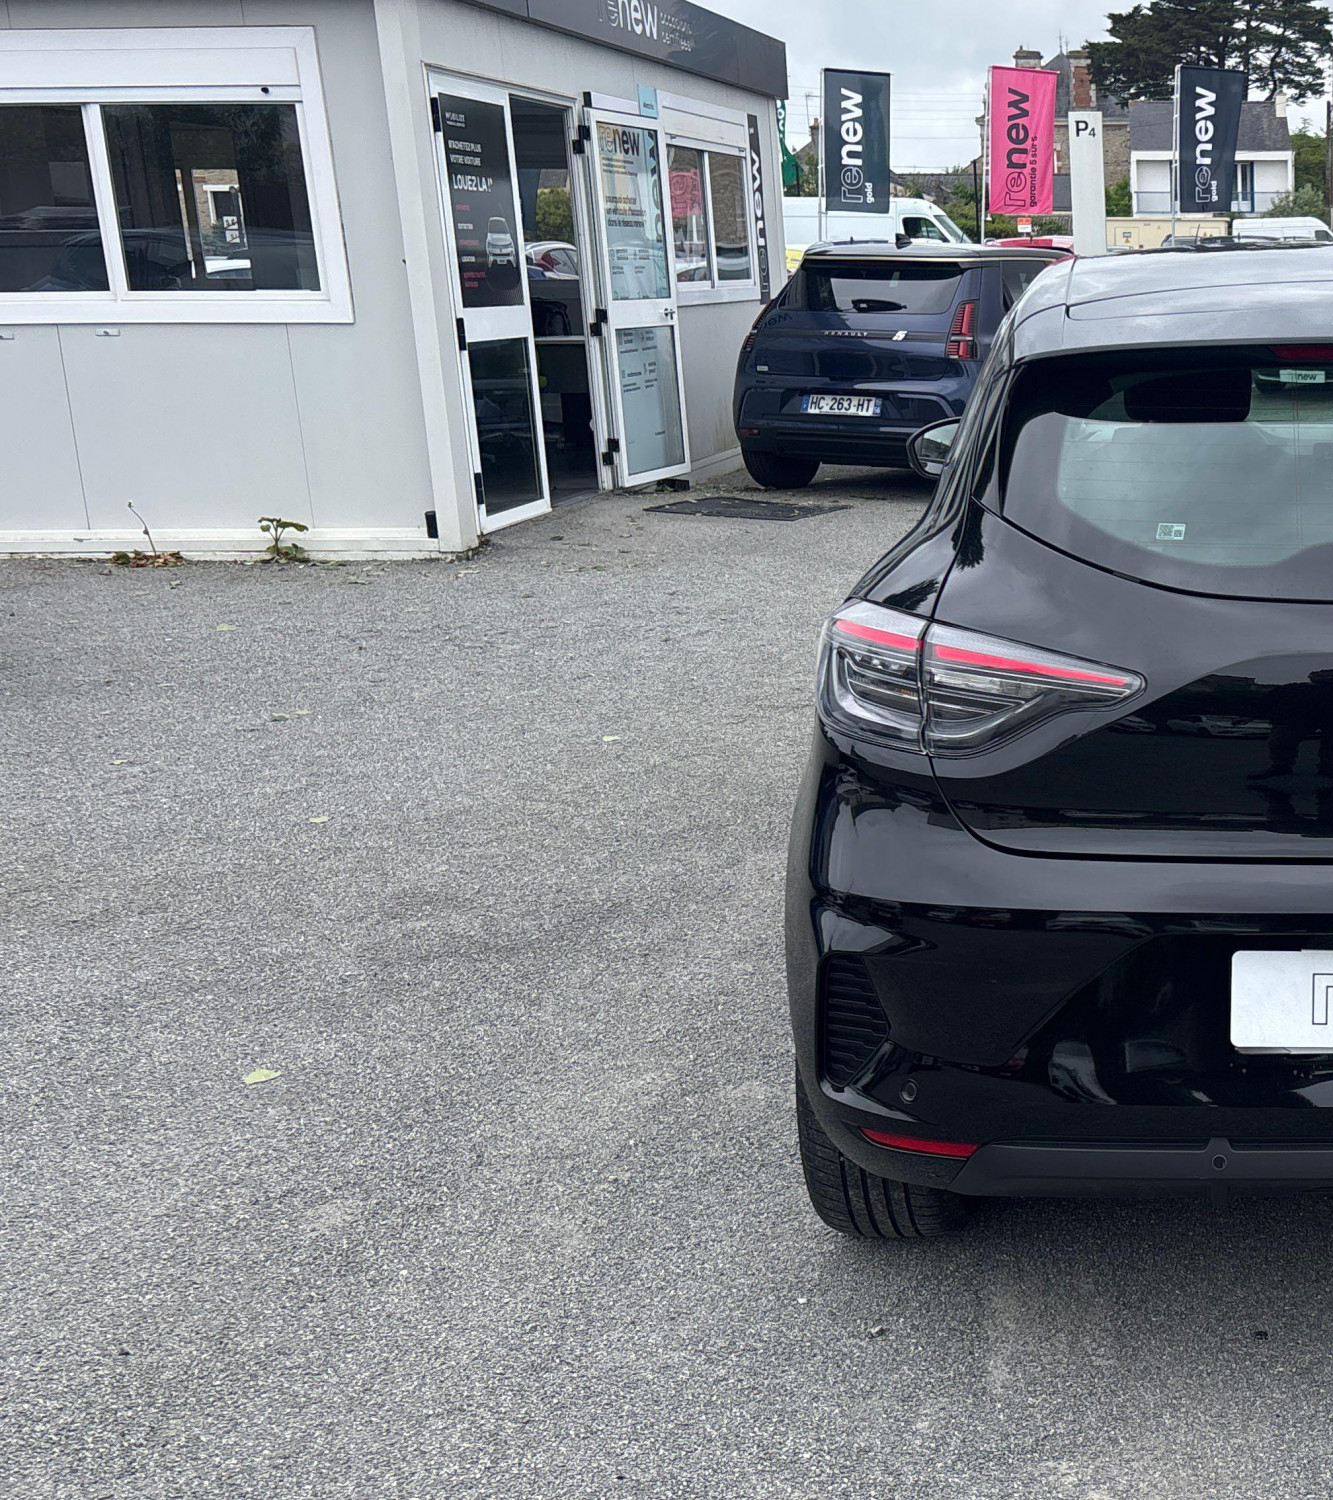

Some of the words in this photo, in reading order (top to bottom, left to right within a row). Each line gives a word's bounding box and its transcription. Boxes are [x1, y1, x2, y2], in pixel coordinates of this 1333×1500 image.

[598, 125, 640, 157] renew
[840, 87, 863, 203] renew
[1004, 87, 1029, 207] renew
[1195, 86, 1217, 203] renew
[452, 173, 477, 192] LOUEZ
[477, 176, 487, 192] LA
[865, 182, 875, 204] gold
[1029, 167, 1037, 208] garantie
